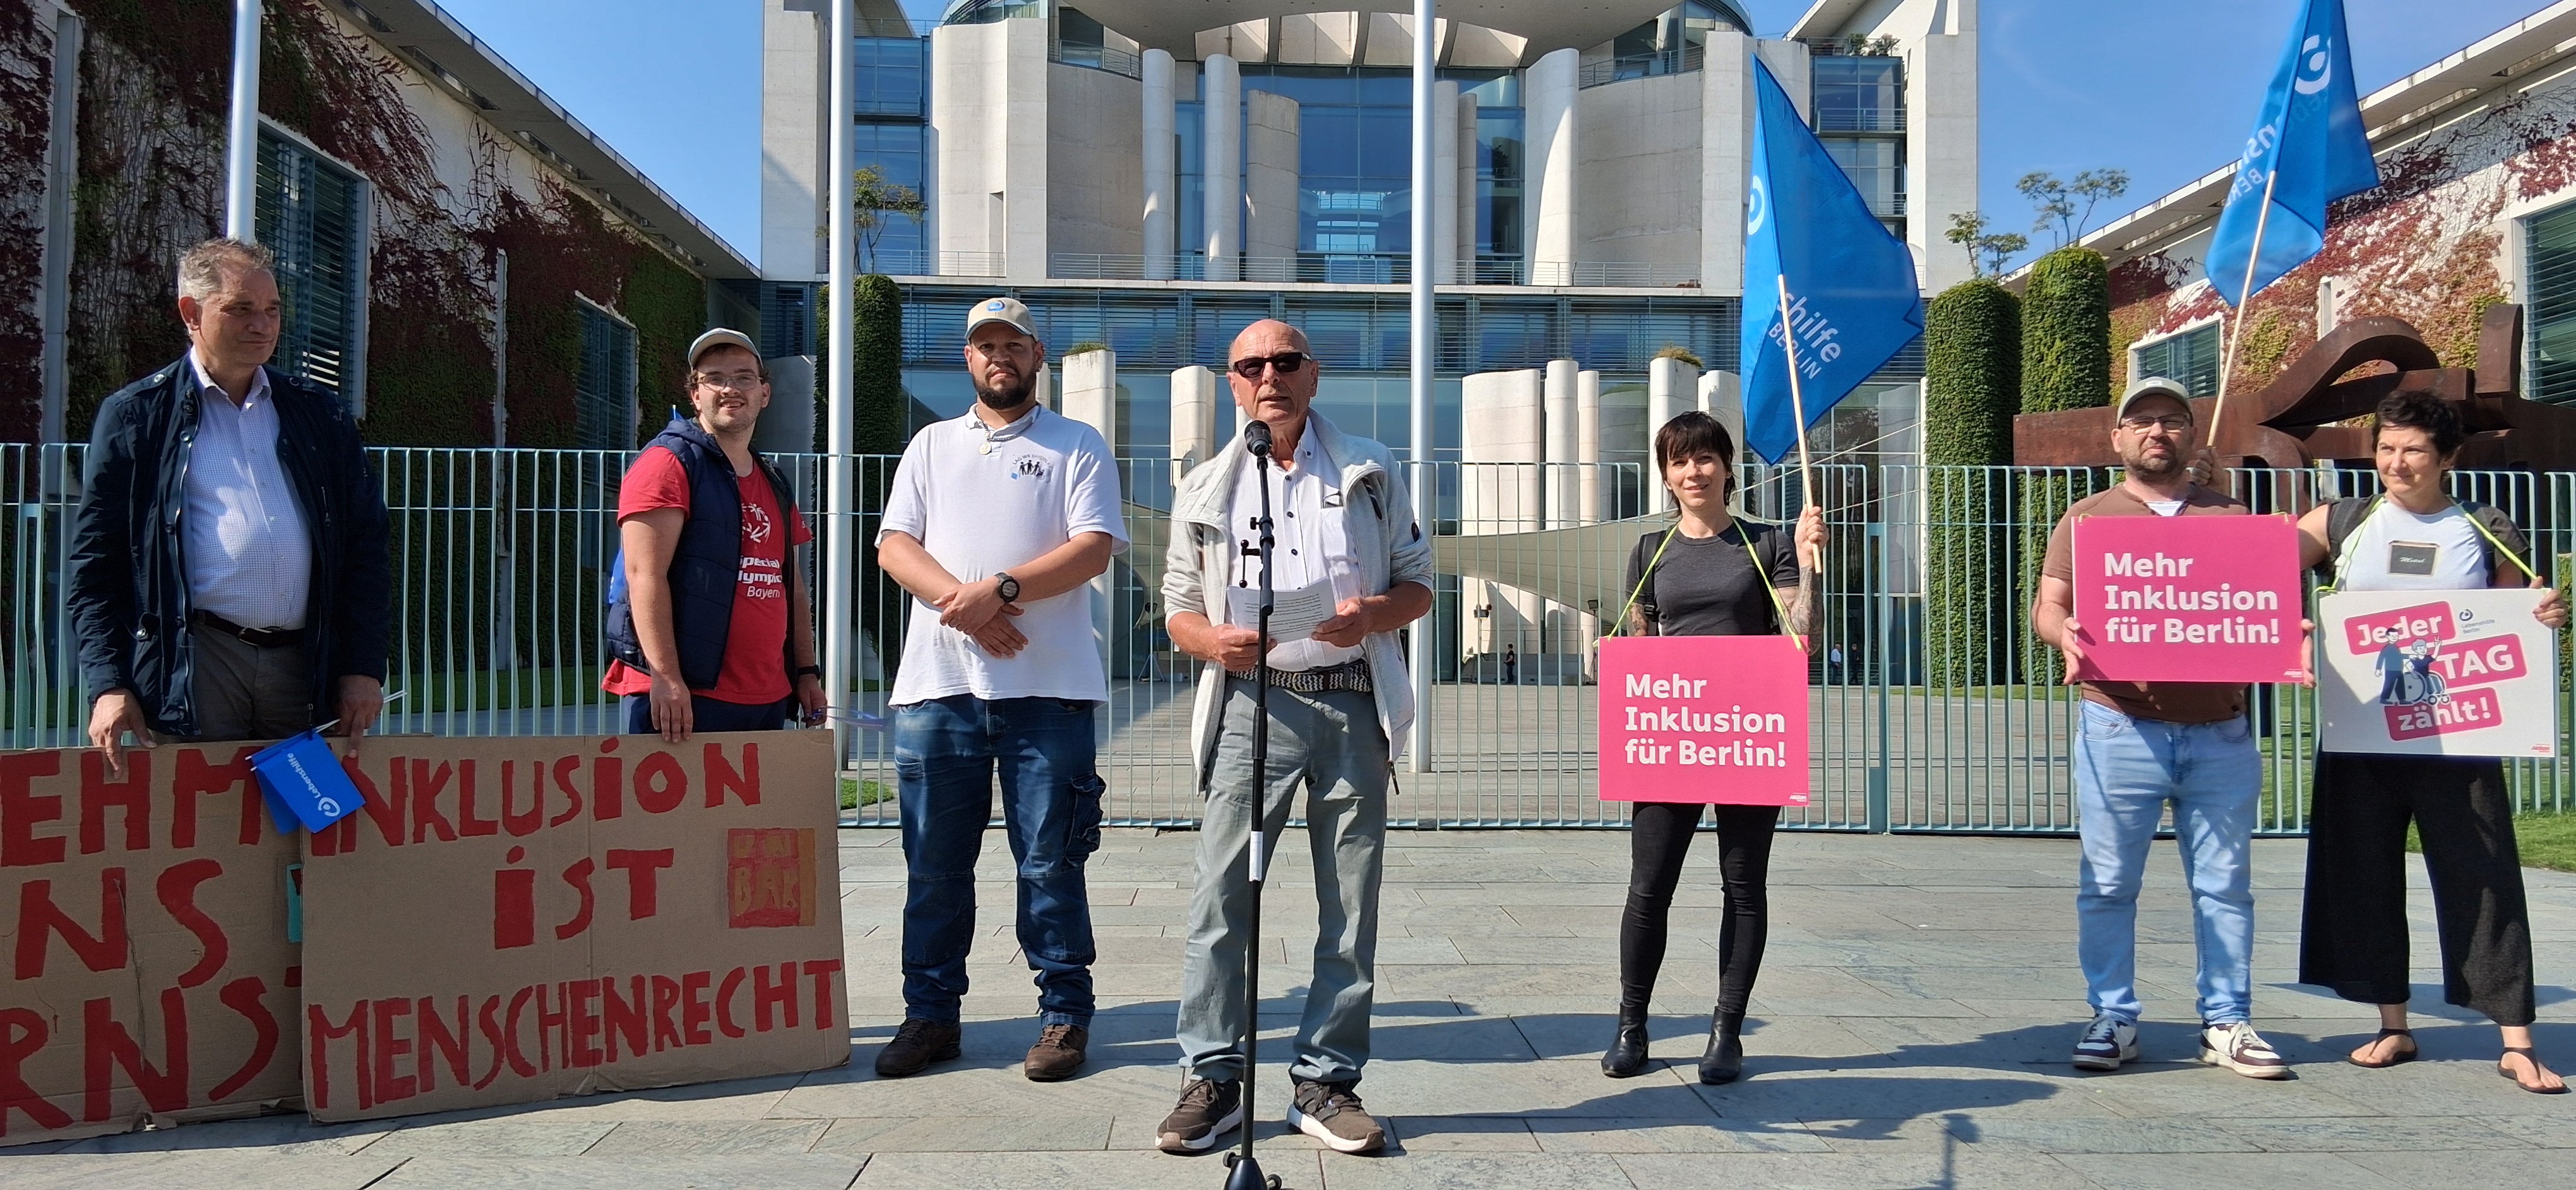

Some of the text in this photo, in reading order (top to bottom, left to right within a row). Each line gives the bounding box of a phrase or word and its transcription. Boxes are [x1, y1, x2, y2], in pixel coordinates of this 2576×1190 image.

[739, 556, 780, 569] pecial
[2104, 552, 2194, 577] Mehr
[747, 586, 780, 600] Bayern
[2104, 582, 2278, 611] Inklusion
[2105, 616, 2281, 644] für Berlin!
[2357, 615, 2442, 646] Jeder
[2436, 644, 2515, 680] TAG
[1625, 673, 1707, 699] Mehr
[1625, 705, 1786, 733] Inklusion
[2398, 696, 2492, 731] zählt!
[1625, 738, 1786, 767] für Berlin!
[287, 752, 322, 799] Lebenshilfe
[307, 959, 842, 1110] MENSCHENRECHT
[0, 967, 302, 1137] RNS
